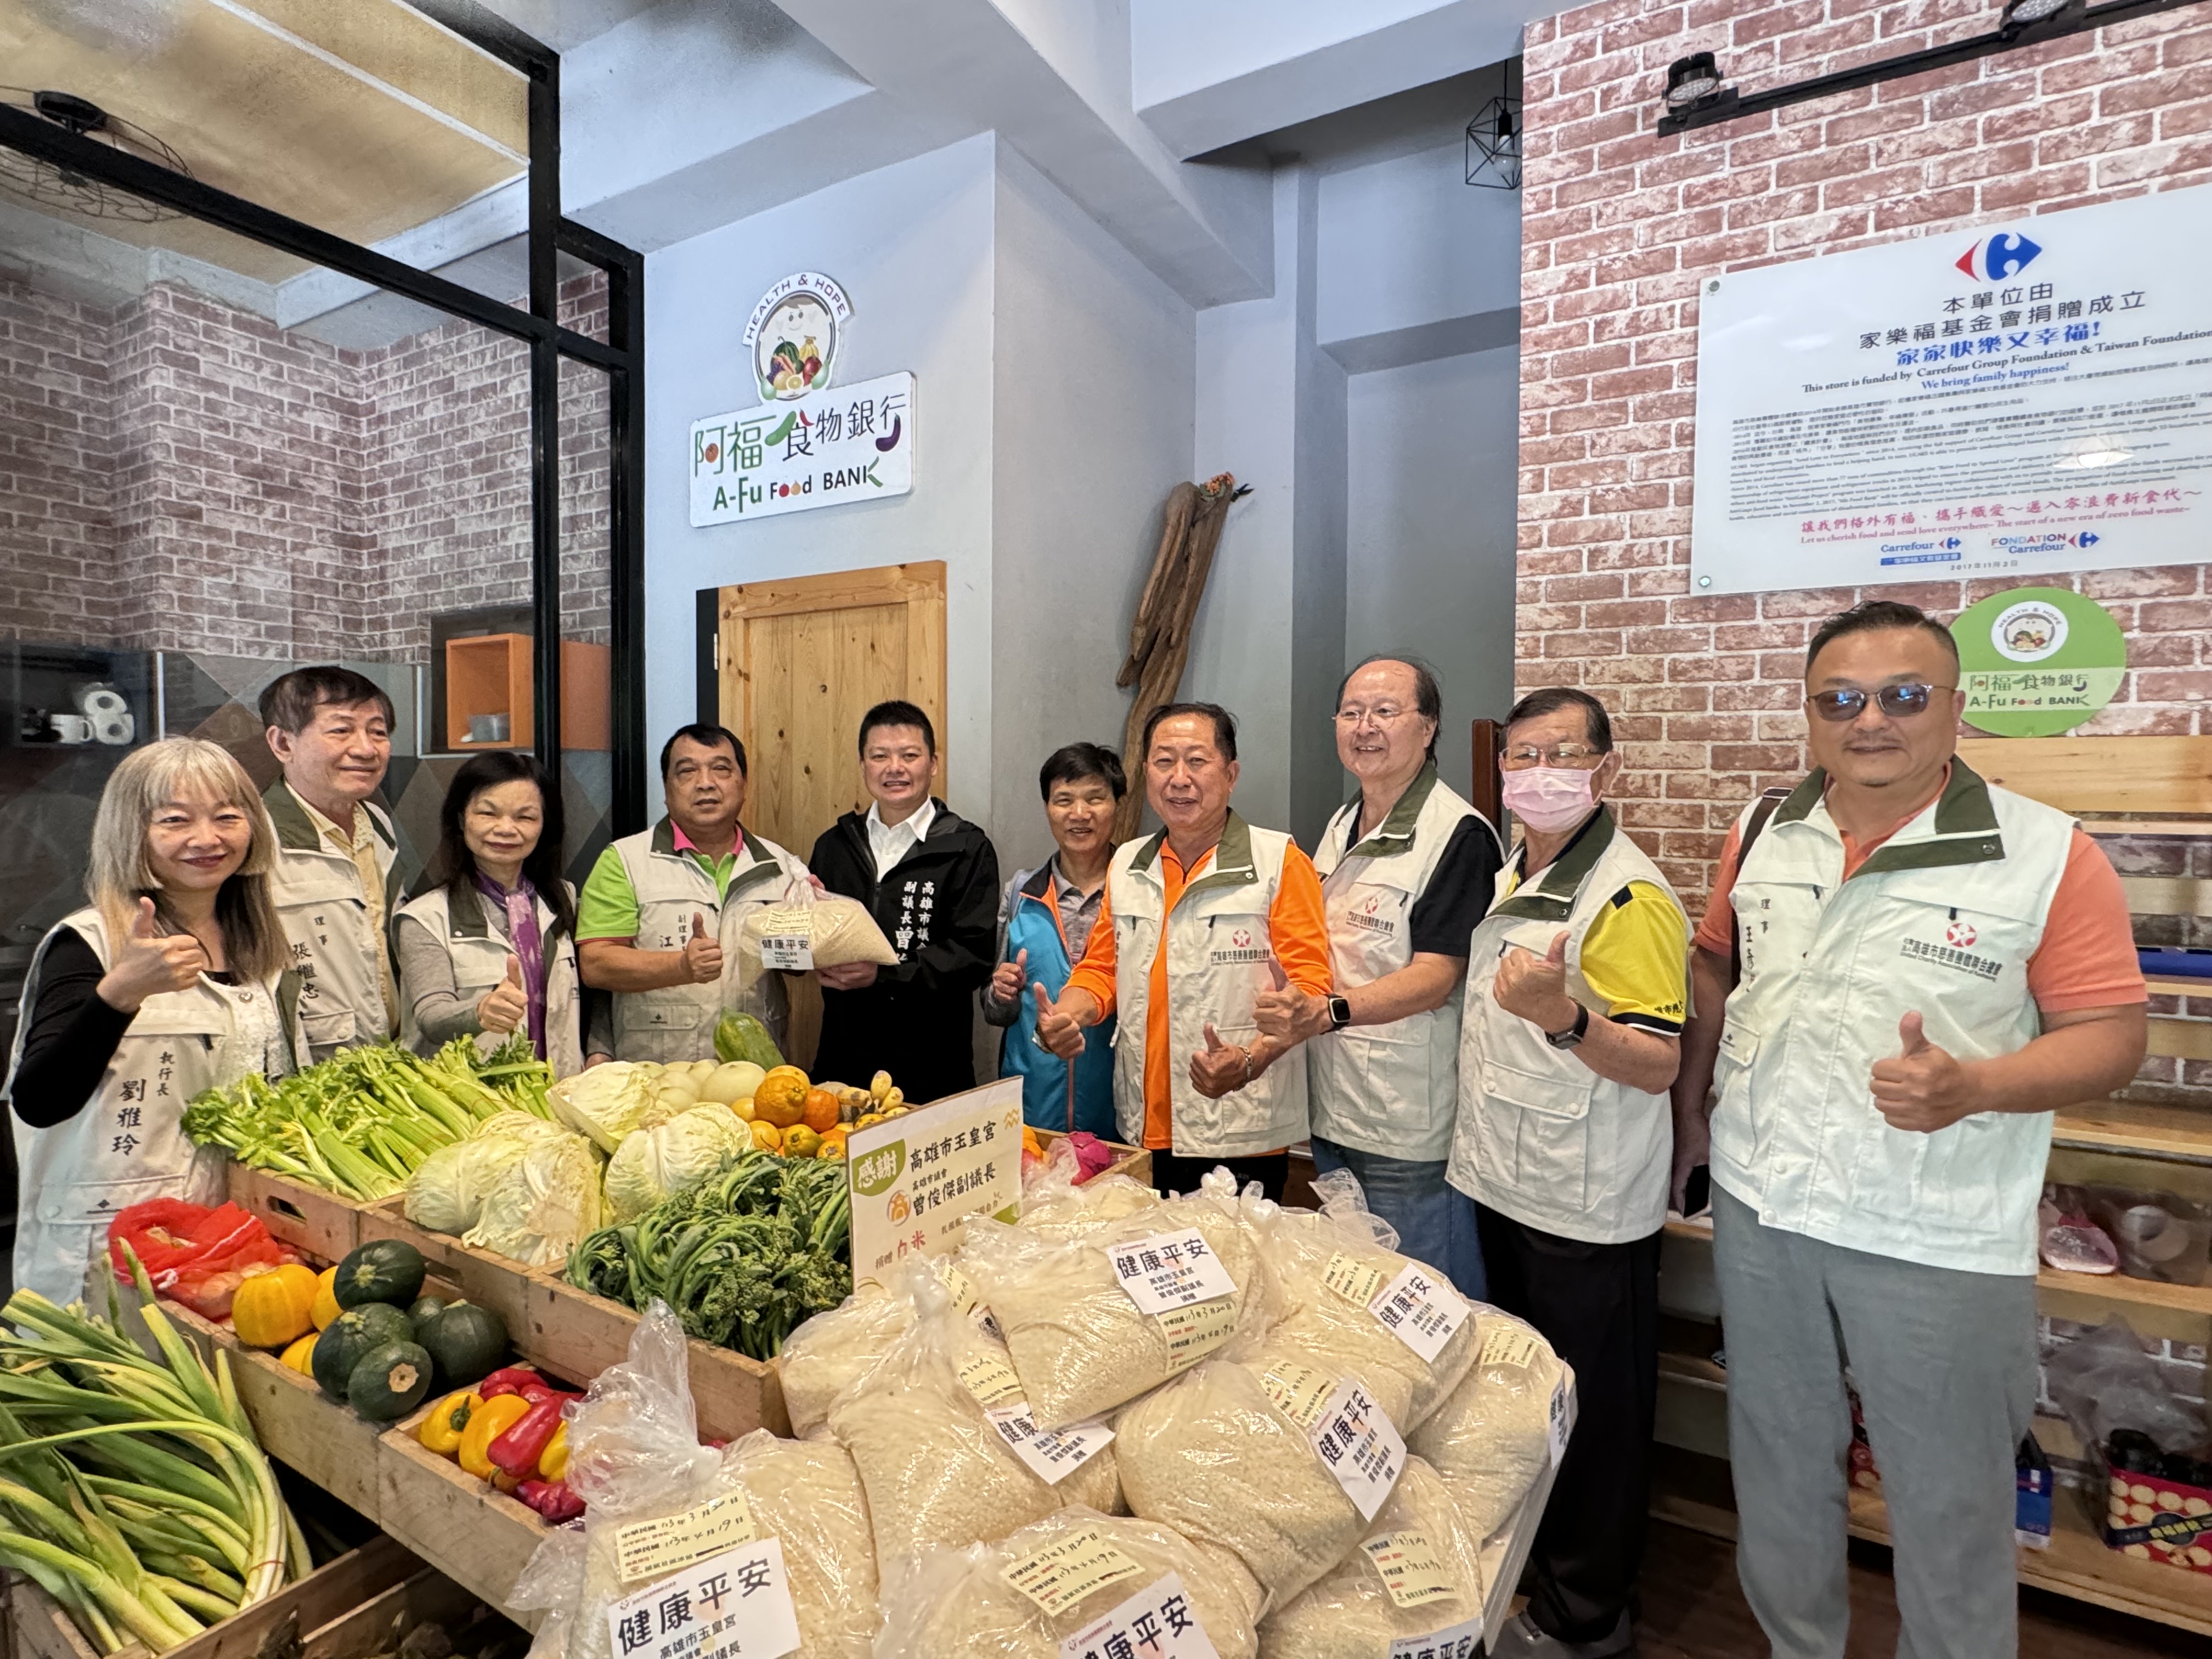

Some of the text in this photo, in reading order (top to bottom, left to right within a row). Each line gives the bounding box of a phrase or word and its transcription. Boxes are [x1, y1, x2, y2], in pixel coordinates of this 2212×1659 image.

[747, 274, 846, 340] HEALTH & HOPE
[1859, 290, 2146, 349] 家樂福基金會捐贈成立
[1943, 282, 2053, 314] 本單位由
[1802, 383, 1824, 393] This
[1825, 381, 1849, 391] store
[1852, 379, 1860, 387] is
[1862, 372, 1897, 385] funded
[1899, 370, 1912, 381] by
[1917, 363, 1970, 377] Carrefour
[1972, 358, 2008, 370] Group
[2011, 348, 2078, 365] Foundation
[2080, 345, 2093, 354] &
[2095, 340, 2139, 353] Taiwan
[1897, 321, 2101, 366] 家家快樂又幸福!
[1921, 362, 2070, 390] We bring family happiness!
[694, 393, 906, 478] 阿福食物銀行
[713, 455, 884, 513] A-Fu Food BANK
[1801, 535, 1815, 544] Let
[1827, 532, 1857, 542] cherish
[1859, 530, 1877, 540] food
[1880, 529, 1894, 537] and
[1897, 527, 1917, 536] send
[1919, 525, 1937, 534] love
[1997, 519, 2013, 527] The
[2038, 515, 2050, 524] of
[2095, 511, 2107, 520] of
[2131, 507, 2154, 516] food
[1881, 541, 1934, 553] Carrefour
[1991, 533, 2067, 547] FONDATION
[2008, 543, 2066, 554] Carrefour
[1969, 674, 2090, 692] 阿福食物銀行
[1969, 694, 2091, 709] A-Fu Food BANK
[292, 941, 319, 999] 張繼忠
[156, 1051, 176, 1097] 執行長
[111, 1078, 148, 1156] 劉雅玲
[857, 1149, 898, 1189] 感謝
[910, 1121, 997, 1173] 高雄市玉皇宮
[913, 1161, 996, 1217] 曾俊傑副議長
[1117, 1238, 1209, 1280] 健康平安
[1379, 1276, 1431, 1329] 健康平安
[1318, 1389, 1373, 1467] 健康平安
[618, 1558, 771, 1657] 健康平安
